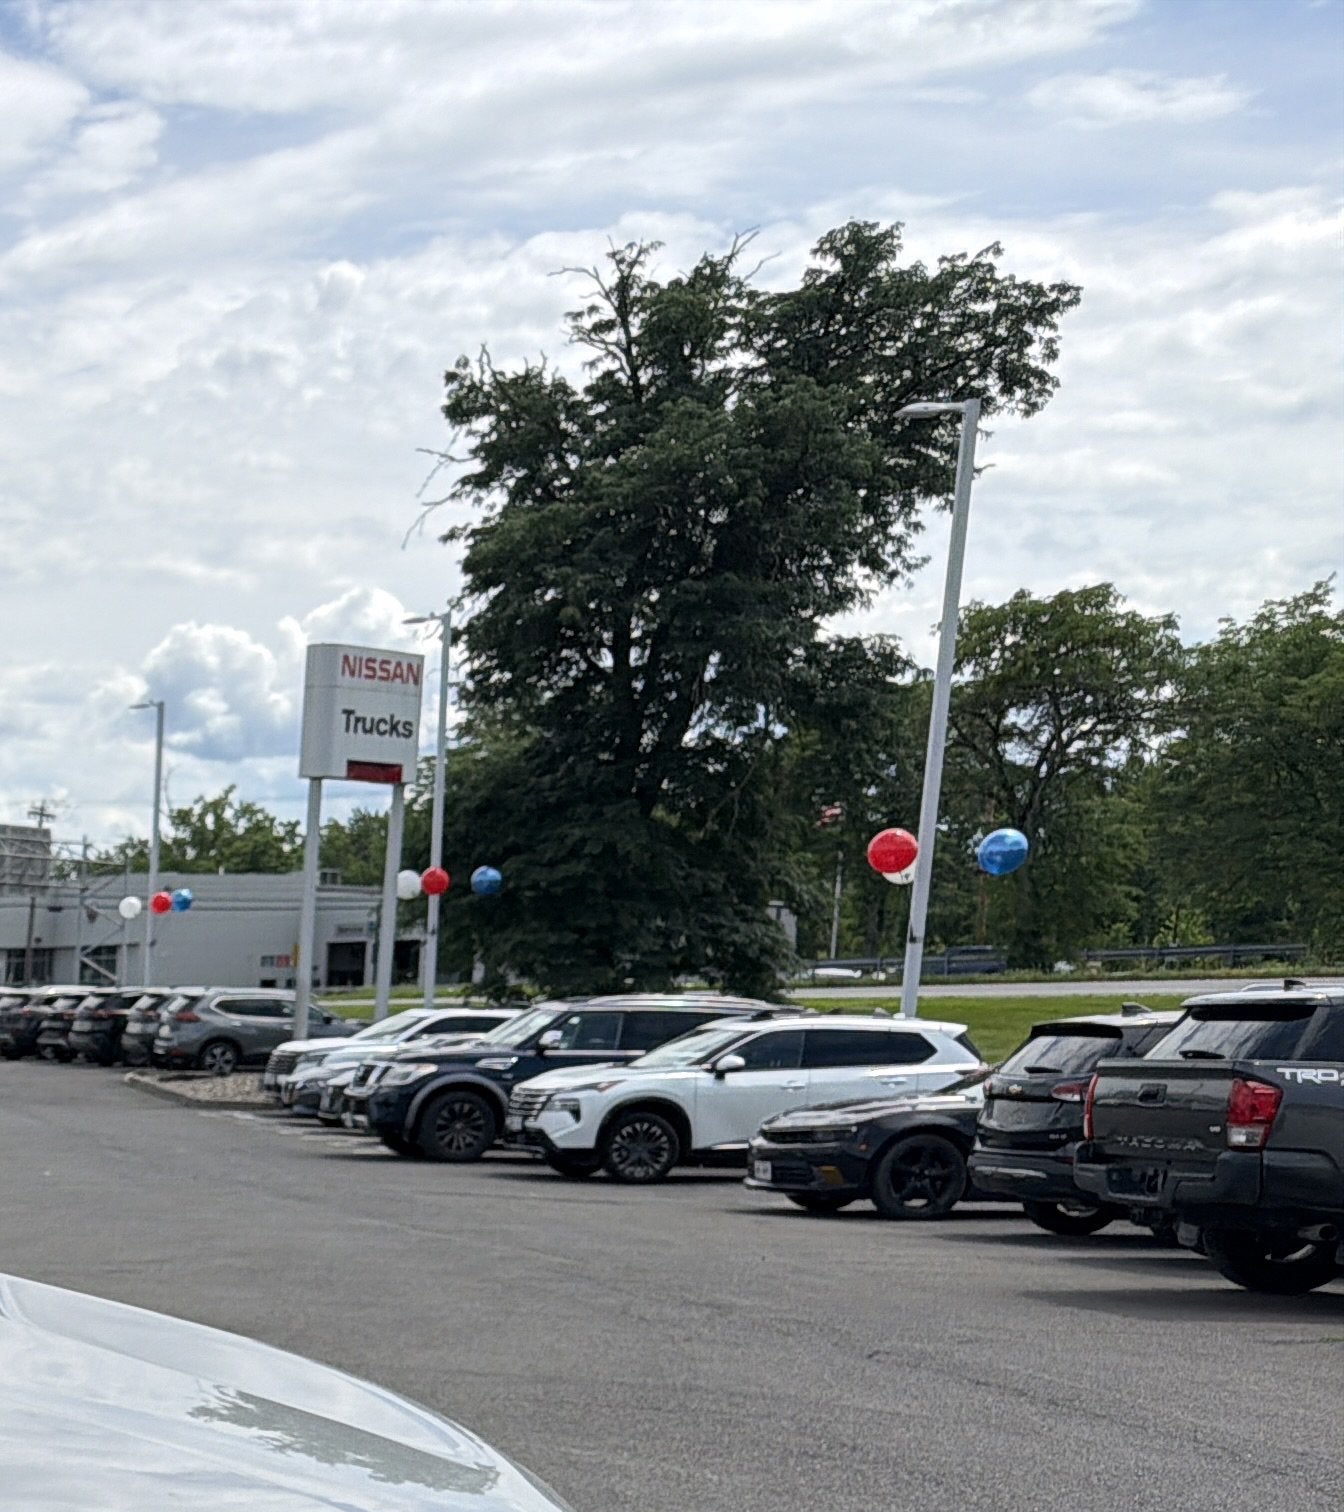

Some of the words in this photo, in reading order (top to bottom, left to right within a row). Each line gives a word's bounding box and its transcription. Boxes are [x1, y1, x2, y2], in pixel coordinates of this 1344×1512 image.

[341, 654, 422, 687] NISSAN
[341, 708, 414, 740] Trucks
[1276, 1067, 1339, 1084] TRD
